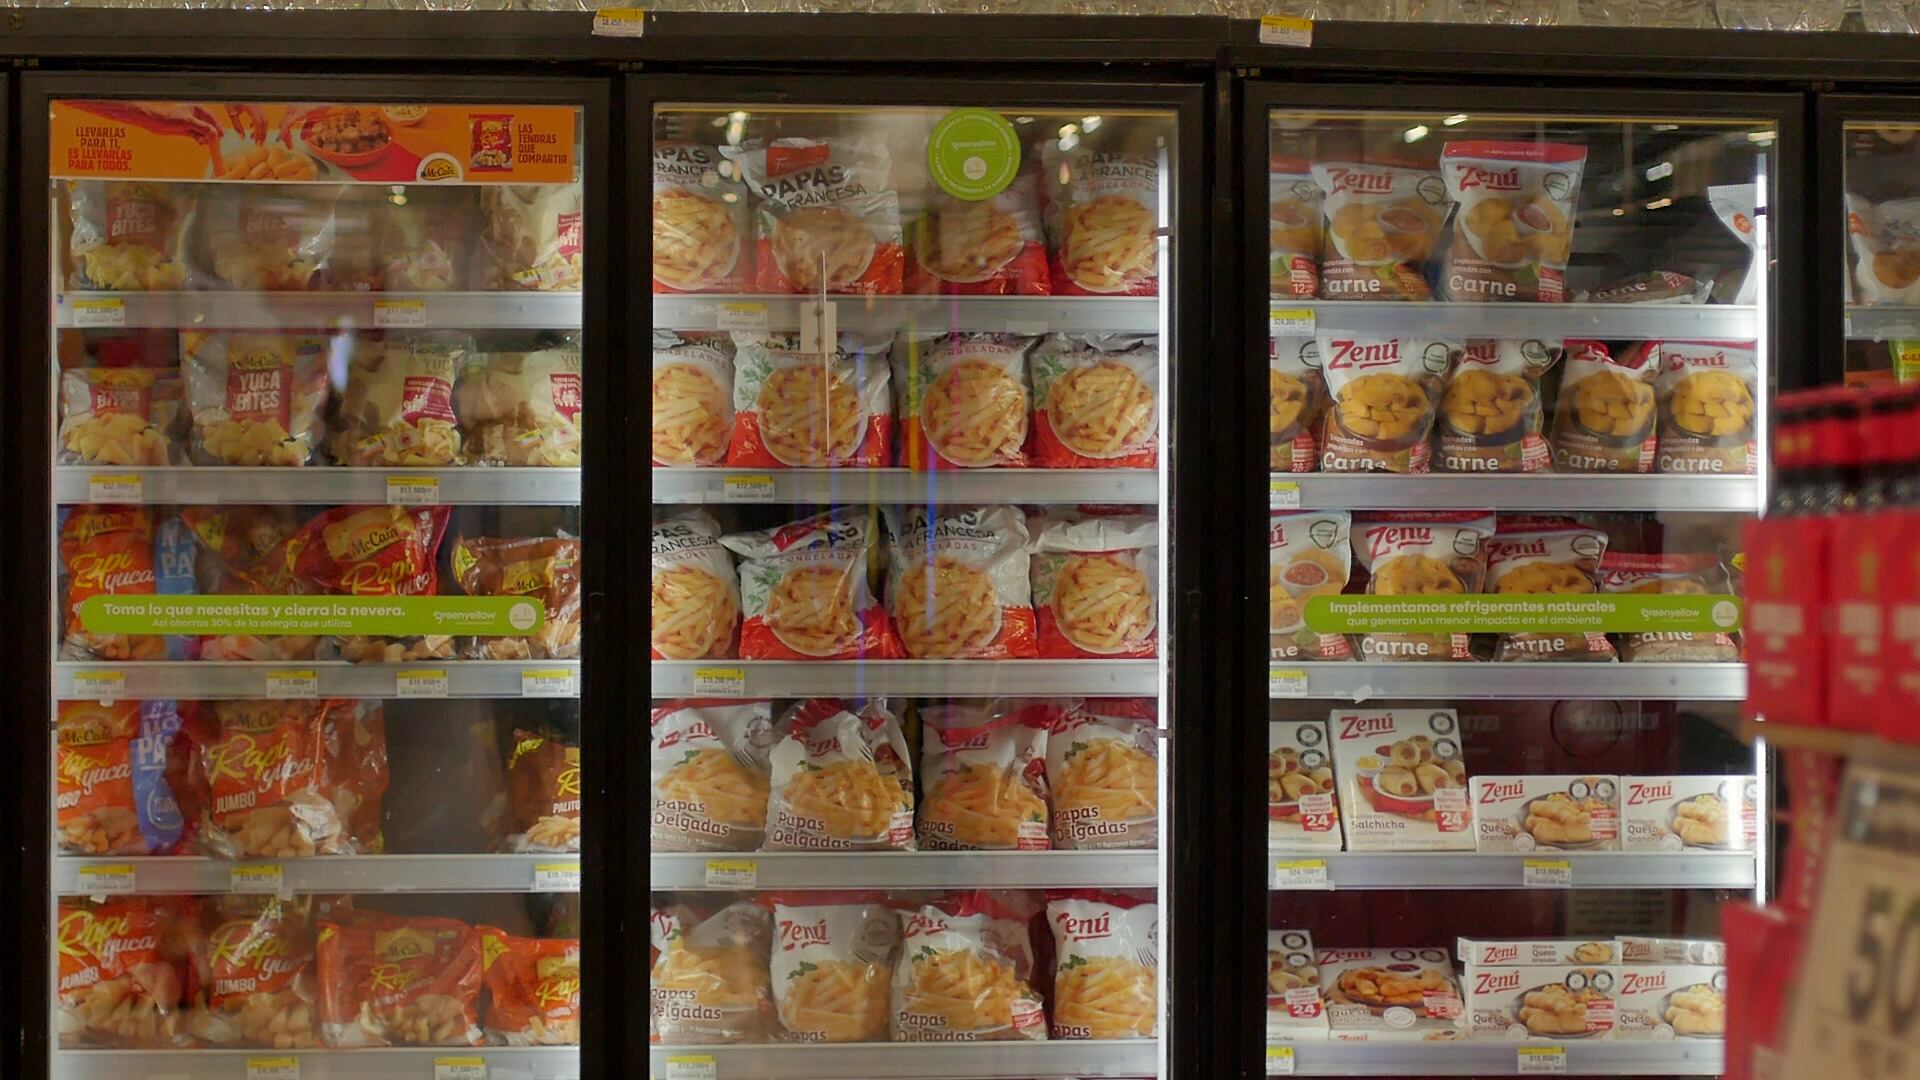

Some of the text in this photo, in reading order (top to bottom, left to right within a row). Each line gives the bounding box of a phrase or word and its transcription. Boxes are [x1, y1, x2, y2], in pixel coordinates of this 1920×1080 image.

[76, 127, 125, 137] LLEVARLAS
[518, 124, 533, 133] LAS
[81, 138, 106, 148] PARA
[518, 134, 556, 144] TENDRAS
[68, 149, 132, 160] ES LLEVARLAS
[518, 144, 535, 154] QUE
[68, 160, 132, 172] PARA TODOS.
[518, 154, 567, 165] COMPARTIR
[426, 168, 455, 179] McCain
[1327, 168, 1393, 194] Zenú
[1457, 165, 1521, 191] Zenú
[112, 218, 155, 236] BITES
[1449, 275, 1517, 296] Carne
[1329, 338, 1402, 370] Zenú
[238, 371, 280, 392] YUCA
[234, 391, 279, 412] BITES
[1323, 452, 1386, 472] Carne
[1555, 449, 1619, 471] Carne
[1661, 455, 1724, 473] Carne
[351, 526, 399, 557] McCain
[1487, 539, 1551, 567] Zenú
[105, 568, 155, 593] yuca
[103, 603, 406, 618] Toma lo que necesitas y cierra la nevera.
[1330, 600, 1616, 614] Implementamos refrigerantes naturales
[1640, 607, 1700, 622] greenyellow
[170, 618, 209, 628] ahorras
[210, 618, 232, 628] 30%
[234, 618, 248, 628] de
[249, 618, 259, 628] la
[300, 620, 319, 629] que
[321, 619, 352, 628] utiliza
[433, 609, 496, 624] greenyellow
[1347, 615, 1602, 627] que generan un menor impacto en el ambiente
[1321, 647, 1336, 656] 12
[1362, 637, 1429, 656] Carne
[1339, 712, 1398, 740] Zenú
[208, 732, 294, 786] Rapi
[82, 764, 132, 795] yuca
[1480, 779, 1526, 804] Zenú
[1627, 781, 1673, 805] Zenú
[215, 792, 257, 814] JUMBO
[656, 799, 706, 814] Papas
[653, 812, 731, 837] Delgadas
[778, 811, 825, 832] Papas
[1307, 814, 1330, 827] 24
[1351, 818, 1406, 831] Salchicha
[1441, 812, 1464, 826] 24
[1480, 823, 1511, 835] Queso
[1627, 824, 1658, 835] Queso
[773, 829, 852, 850] Delgadas
[58, 910, 129, 960] Rapi
[779, 918, 832, 951] Zenú
[101, 936, 156, 969] yuca
[1483, 944, 1519, 963] Zenú
[1532, 948, 1557, 958] Queso
[1622, 941, 1652, 958] Zenú
[215, 977, 256, 996] JUMBO
[1474, 970, 1521, 995] Zenú
[1620, 970, 1667, 995] Zenú
[1293, 1003, 1315, 1015] 24
[900, 1011, 947, 1028] Papas
[1474, 1014, 1504, 1026] Queso
[1620, 1014, 1651, 1026] Queso
